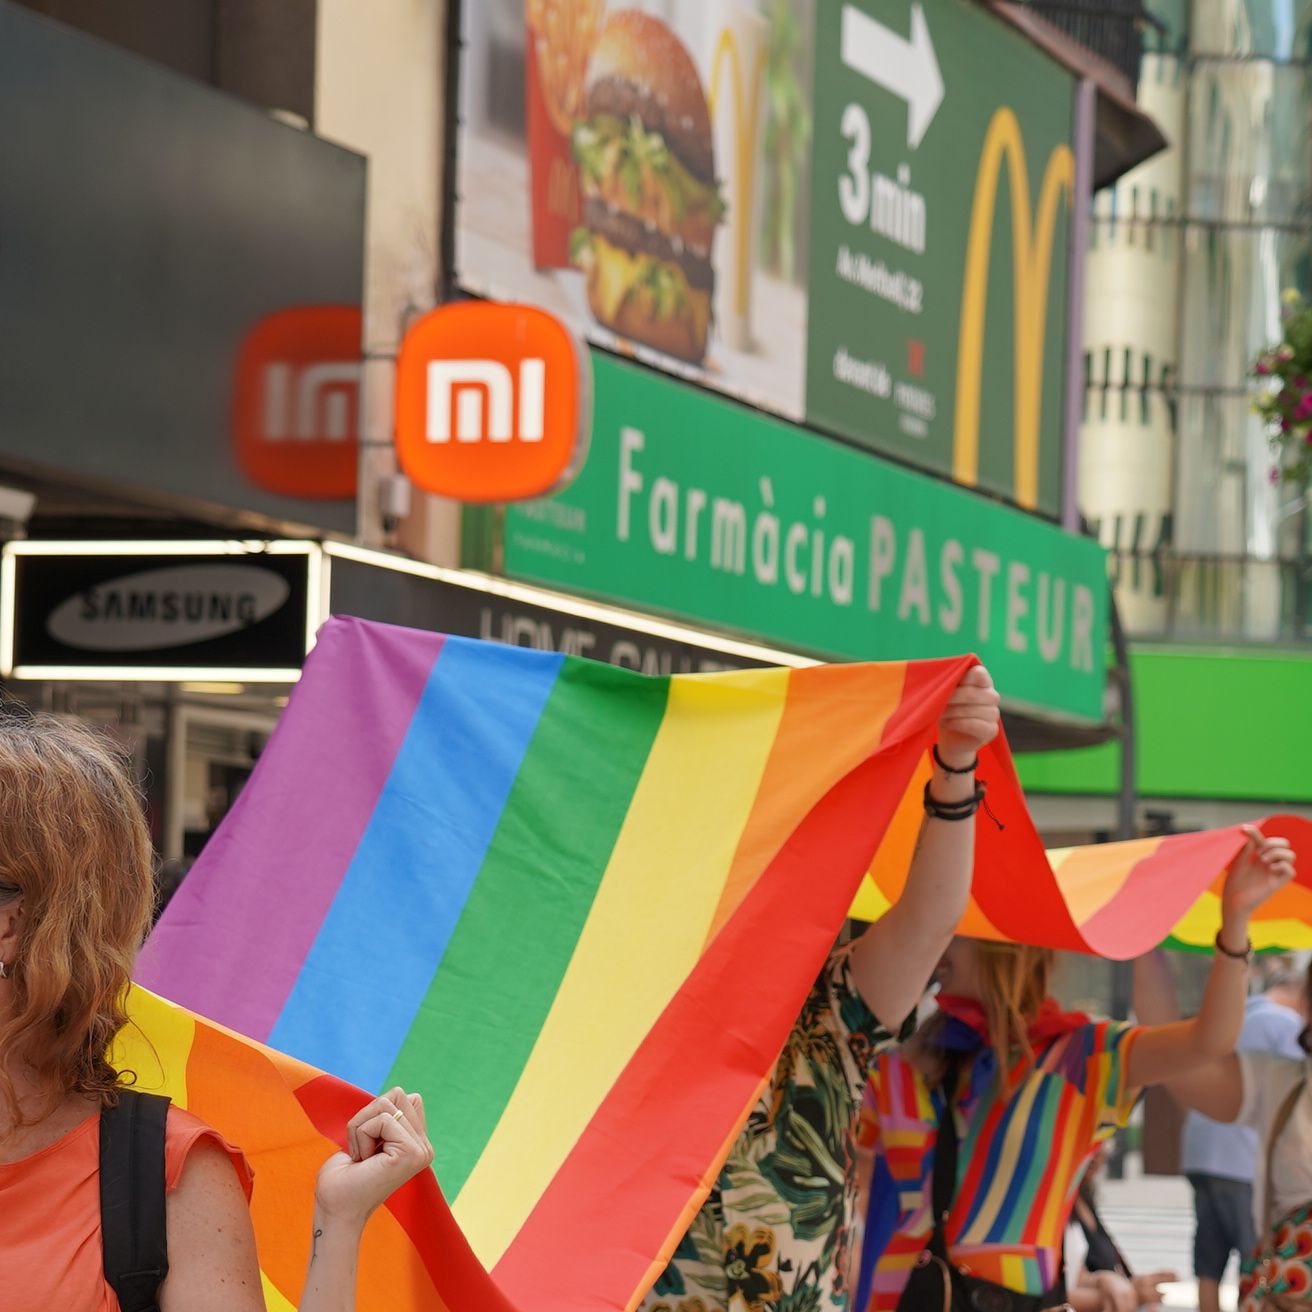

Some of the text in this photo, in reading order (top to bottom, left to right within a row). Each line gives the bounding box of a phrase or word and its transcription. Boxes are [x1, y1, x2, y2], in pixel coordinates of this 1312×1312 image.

[838, 103, 871, 226] 3
[870, 163, 926, 255] min
[80, 588, 260, 626] SAMSUNG
[616, 426, 1095, 672] Farmàcia PASTEUR
